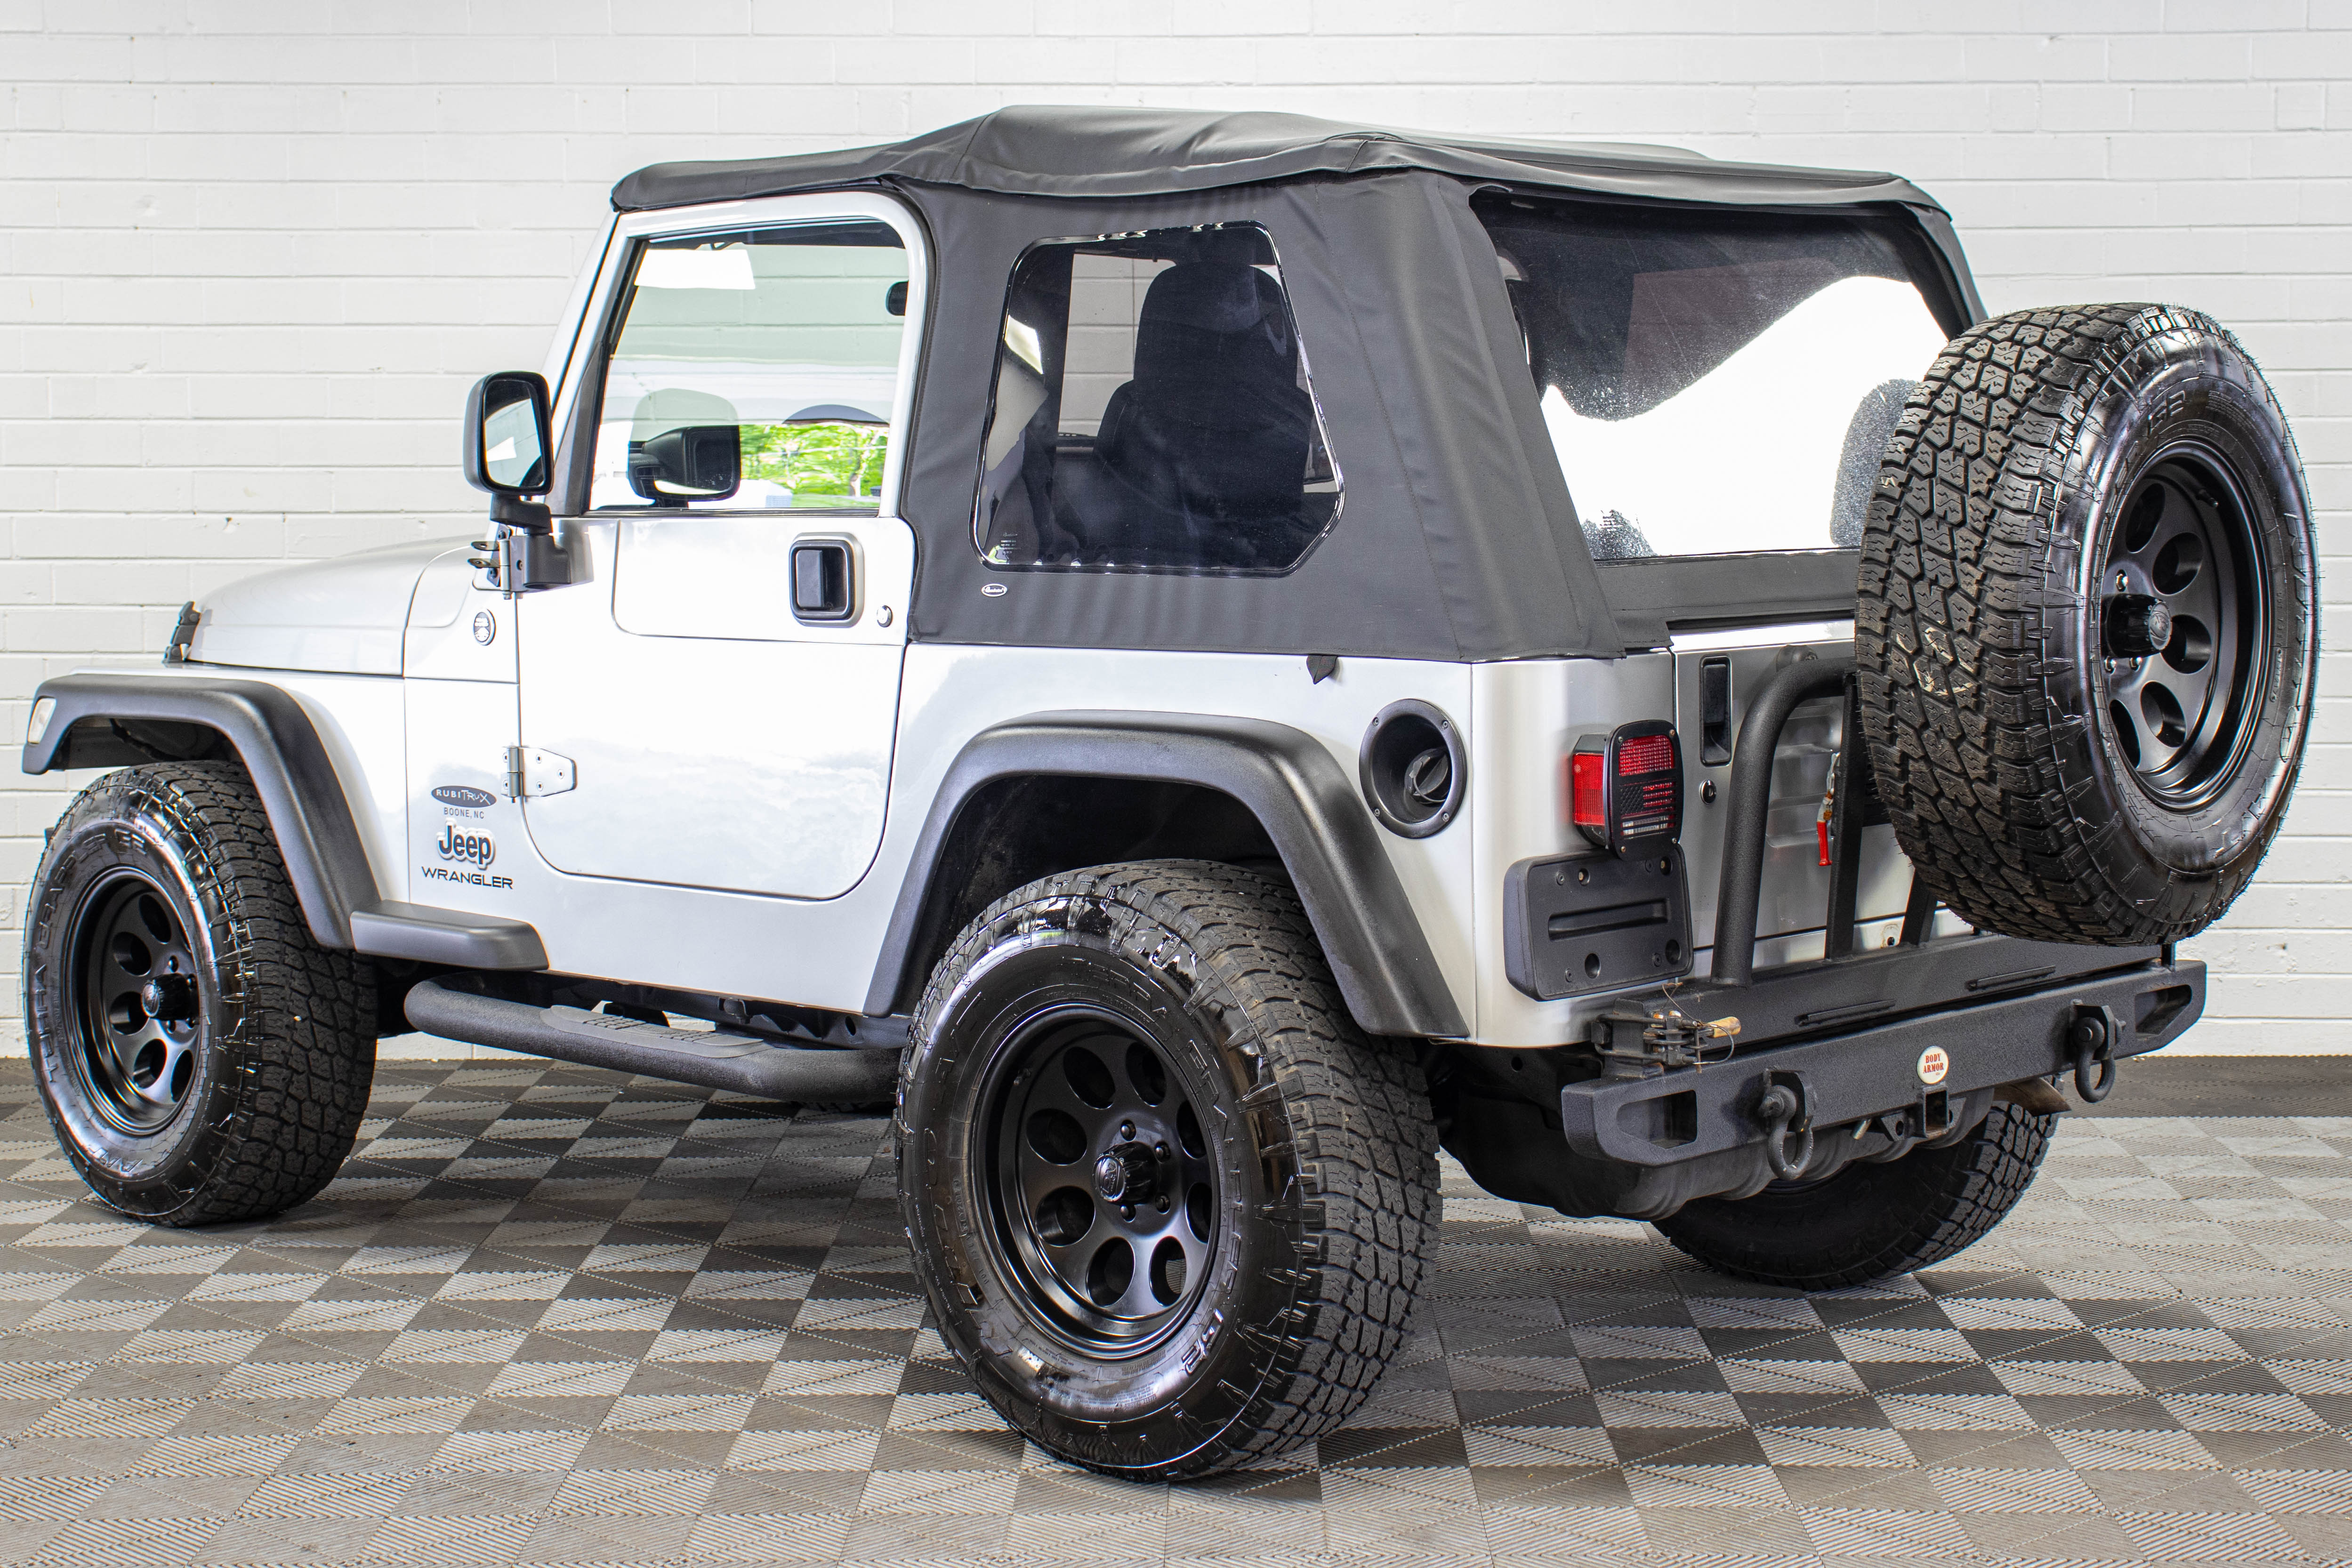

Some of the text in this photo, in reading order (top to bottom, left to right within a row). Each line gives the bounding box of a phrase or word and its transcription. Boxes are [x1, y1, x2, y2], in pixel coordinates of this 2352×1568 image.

[444, 807, 472, 819] BOONE,
[438, 825, 492, 865] Jeep
[421, 866, 513, 889] WRANGLER
[1925, 1053, 1941, 1063] BODY
[1923, 1062, 1944, 1074] ARMOR
